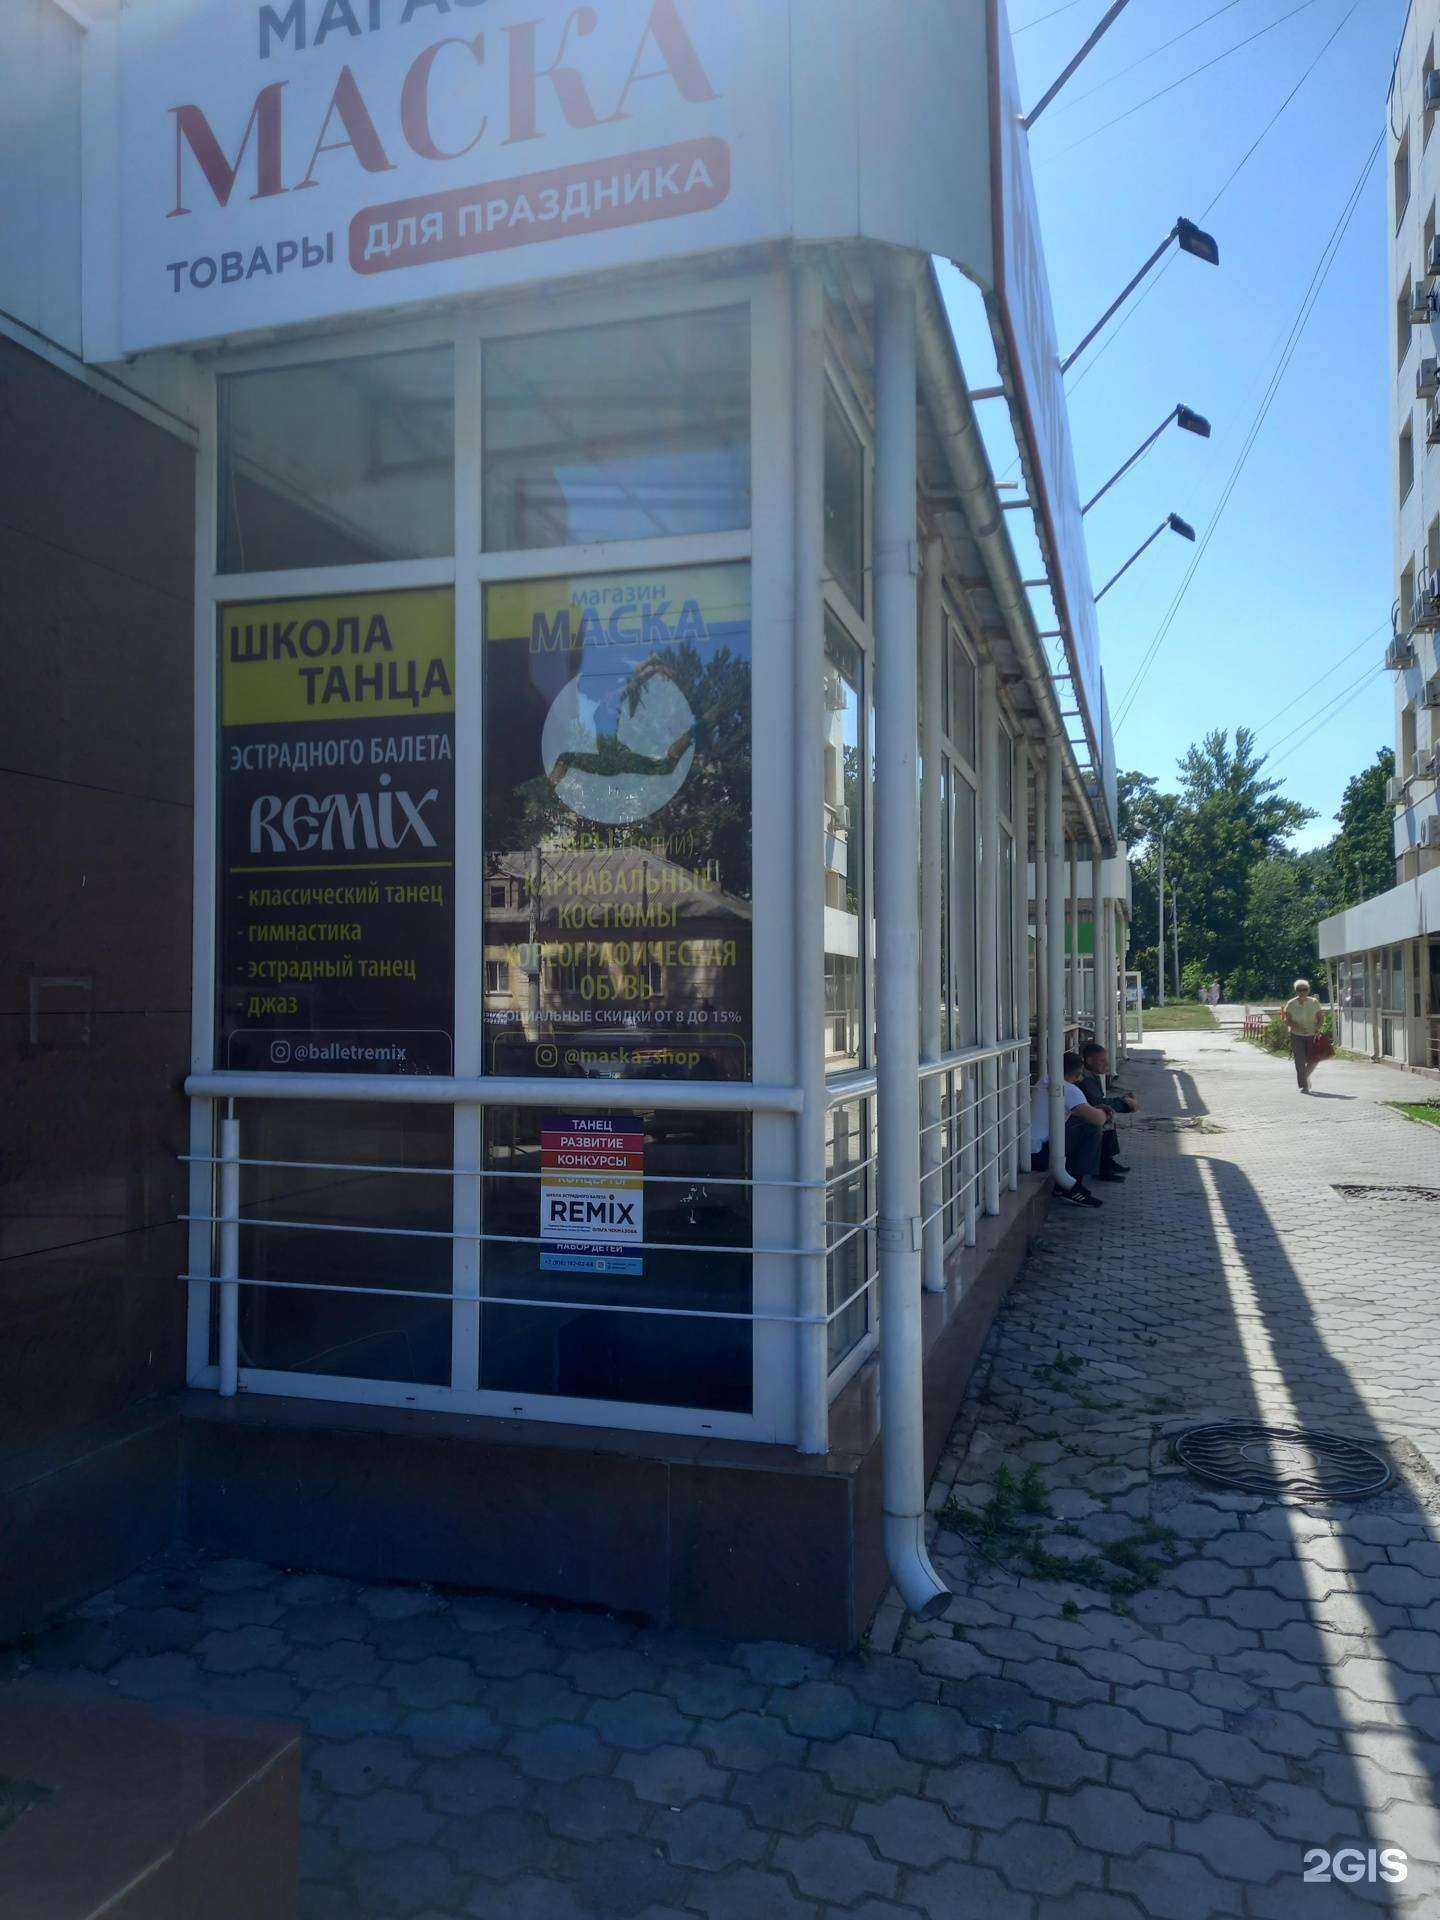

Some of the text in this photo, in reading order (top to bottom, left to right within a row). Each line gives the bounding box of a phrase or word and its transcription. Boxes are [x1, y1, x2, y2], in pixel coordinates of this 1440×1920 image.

[166, 0, 722, 218] МАСКА
[166, 157, 713, 293] ТОВАРЫ ДЛЯ ПРАЗДНИКА
[571, 584, 667, 606] магазин
[230, 614, 393, 663] ШКОЛА
[529, 597, 711, 654] МАСКА
[299, 658, 452, 708] ТАНЦА
[230, 733, 452, 772] ЭСТРАДНОГО БАЛЕТА
[249, 881, 443, 907] классический танец
[558, 900, 677, 928] КОСТЮМЫ
[249, 922, 363, 943] гимнастика
[248, 954, 416, 983] эстрадный танец
[580, 974, 653, 1001] ОБУВЬ
[248, 995, 298, 1018] джаз
[595, 1010, 651, 1024] СКИДКИ
[654, 1010, 672, 1023] ОТ
[676, 1011, 684, 1022] 8
[687, 1011, 708, 1025] ДО
[712, 1011, 742, 1023] 15%
[294, 1041, 406, 1062] @balletremix
[572, 1119, 613, 1132] ТАНЕЦ
[560, 1136, 624, 1149] РАЗВИТИЕ
[557, 1154, 627, 1167] КОНКУРСЫ
